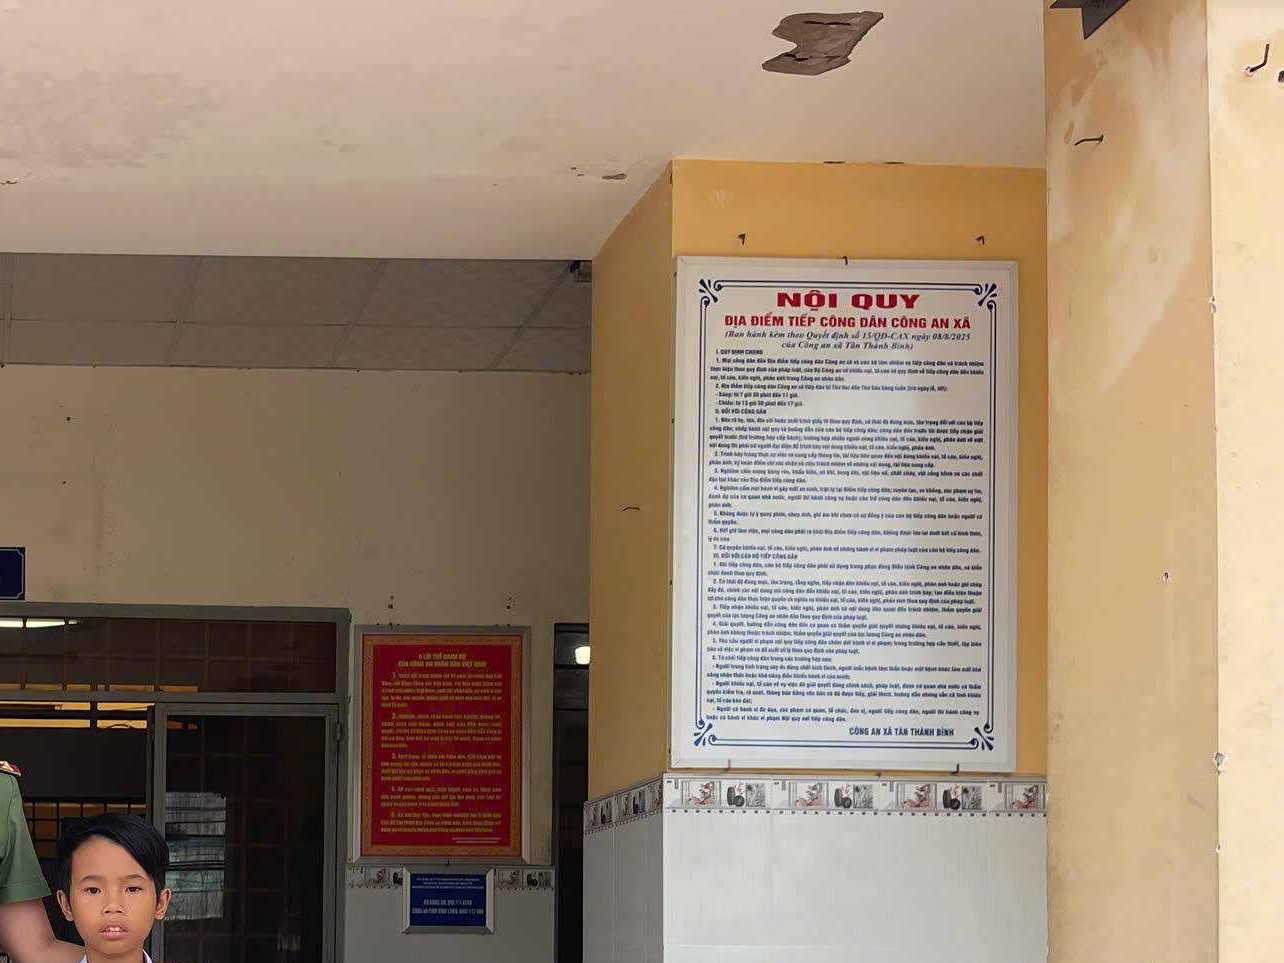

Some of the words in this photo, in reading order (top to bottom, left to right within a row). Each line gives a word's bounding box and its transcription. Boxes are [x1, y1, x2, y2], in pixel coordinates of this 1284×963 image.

[777, 290, 837, 311] NỘI
[852, 294, 920, 310] QUY
[724, 315, 747, 328] ĐỊA
[751, 312, 785, 326] ĐIỂM
[789, 314, 816, 327] TIẾP
[820, 316, 856, 328] CÔNG
[859, 317, 887, 328] DÂN
[891, 317, 927, 328] CÔNG
[931, 318, 949, 329] AN
[954, 318, 971, 329] XÃ
